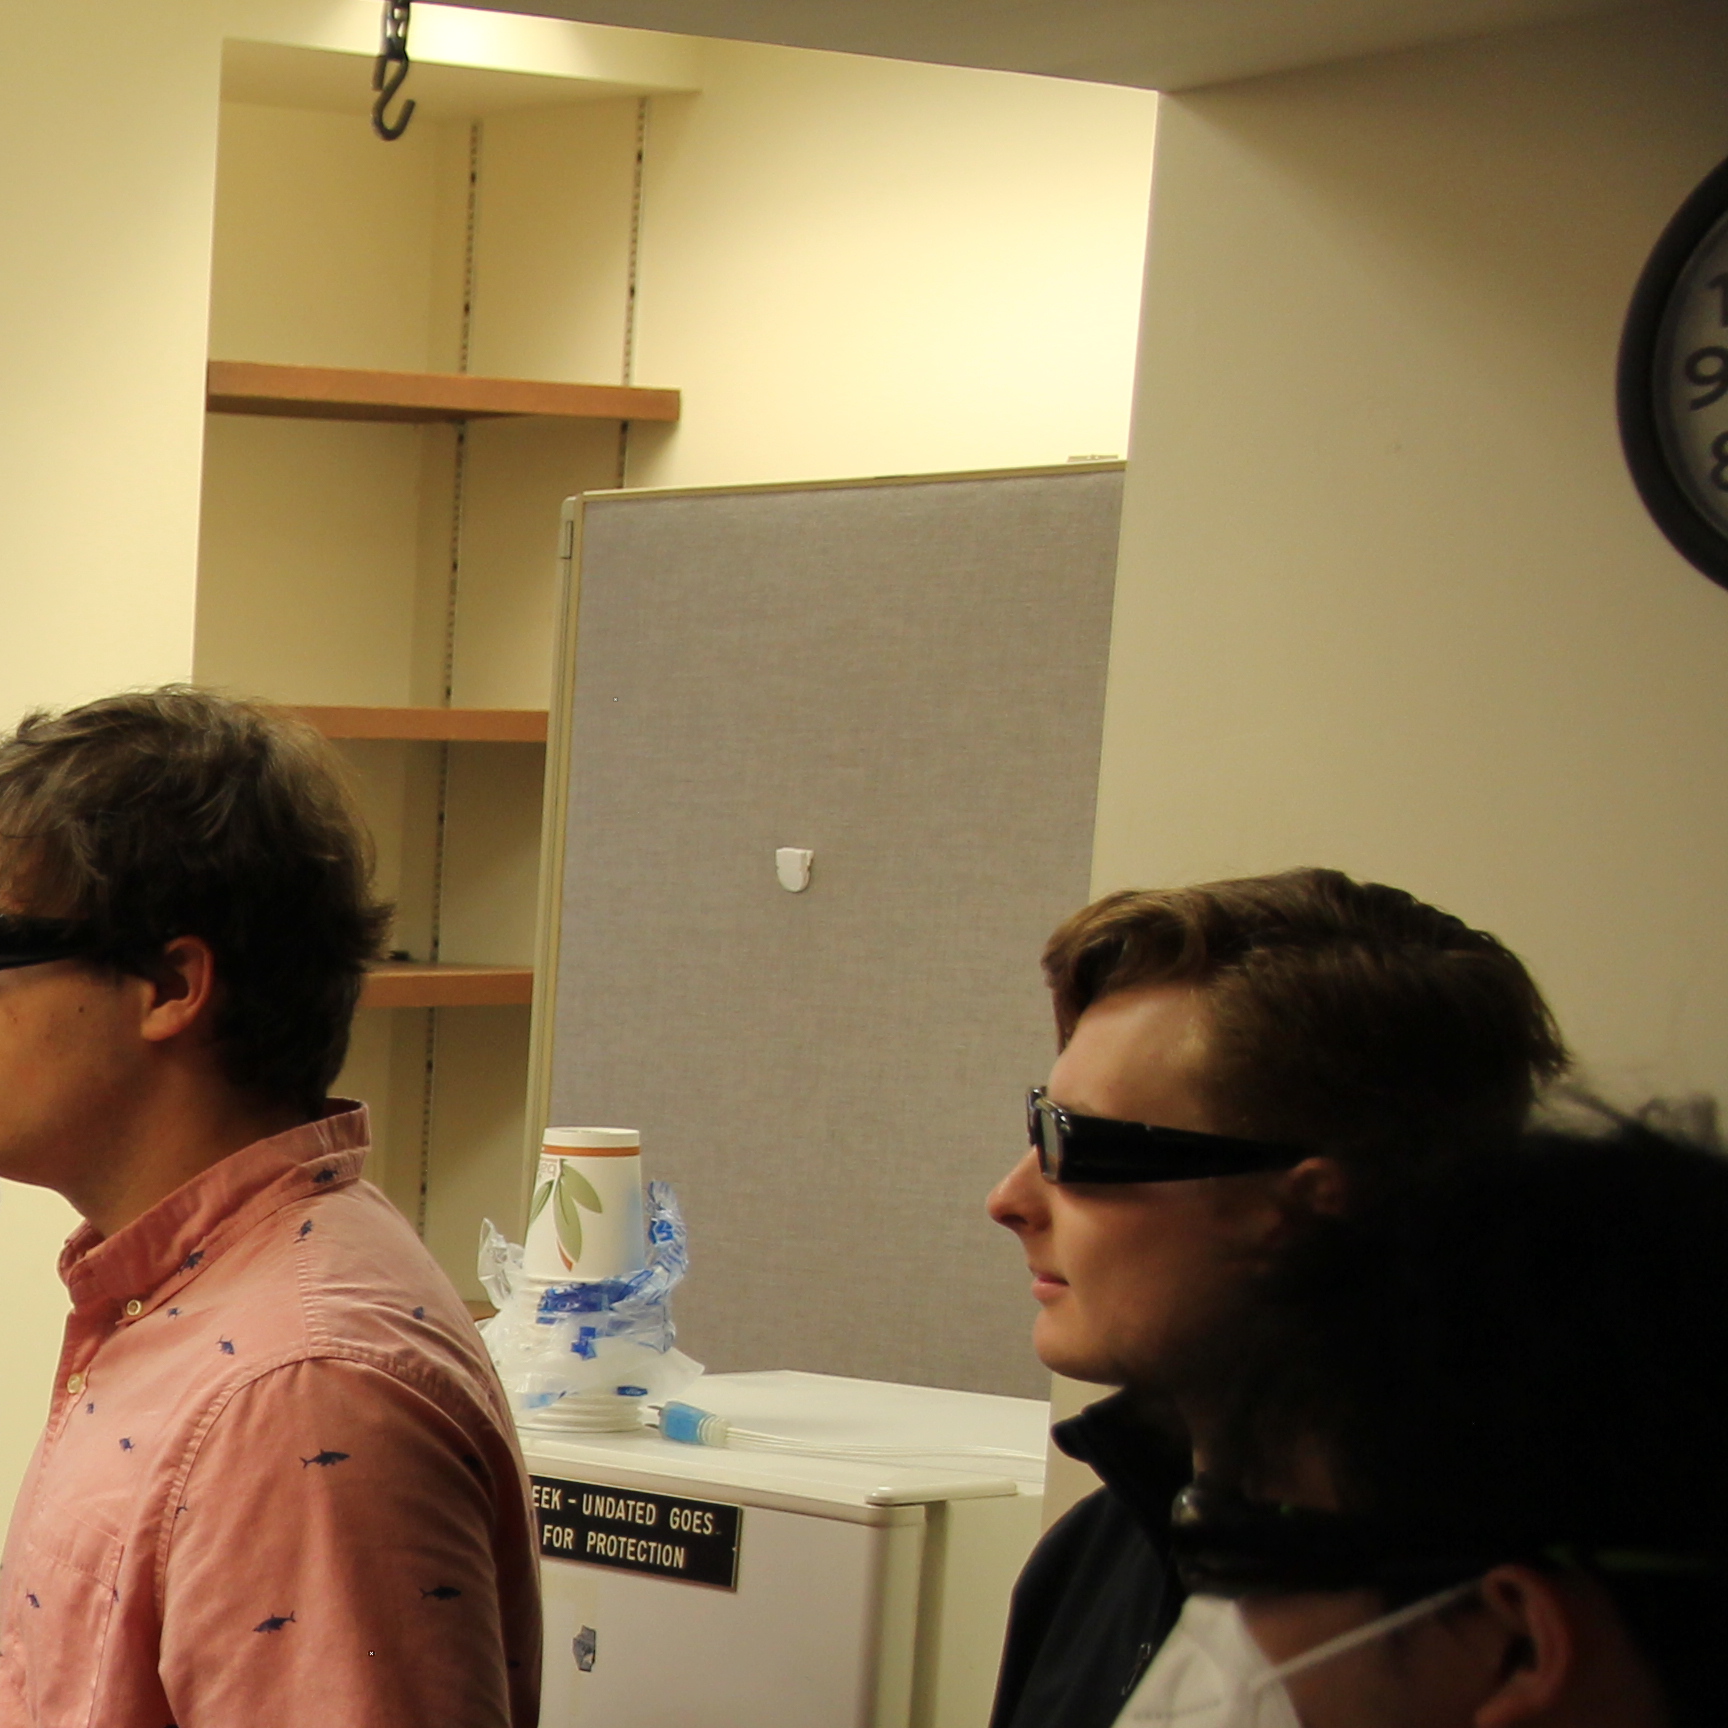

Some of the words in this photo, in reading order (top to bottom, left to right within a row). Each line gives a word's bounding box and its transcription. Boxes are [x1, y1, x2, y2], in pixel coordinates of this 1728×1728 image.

[1685, 345, 1728, 411] 9
[532, 1485, 562, 1511] EEK
[582, 1493, 657, 1526] UNDATED
[669, 1507, 714, 1536] GOES
[542, 1523, 575, 1550] FOR
[586, 1531, 686, 1569] PROTECTION
